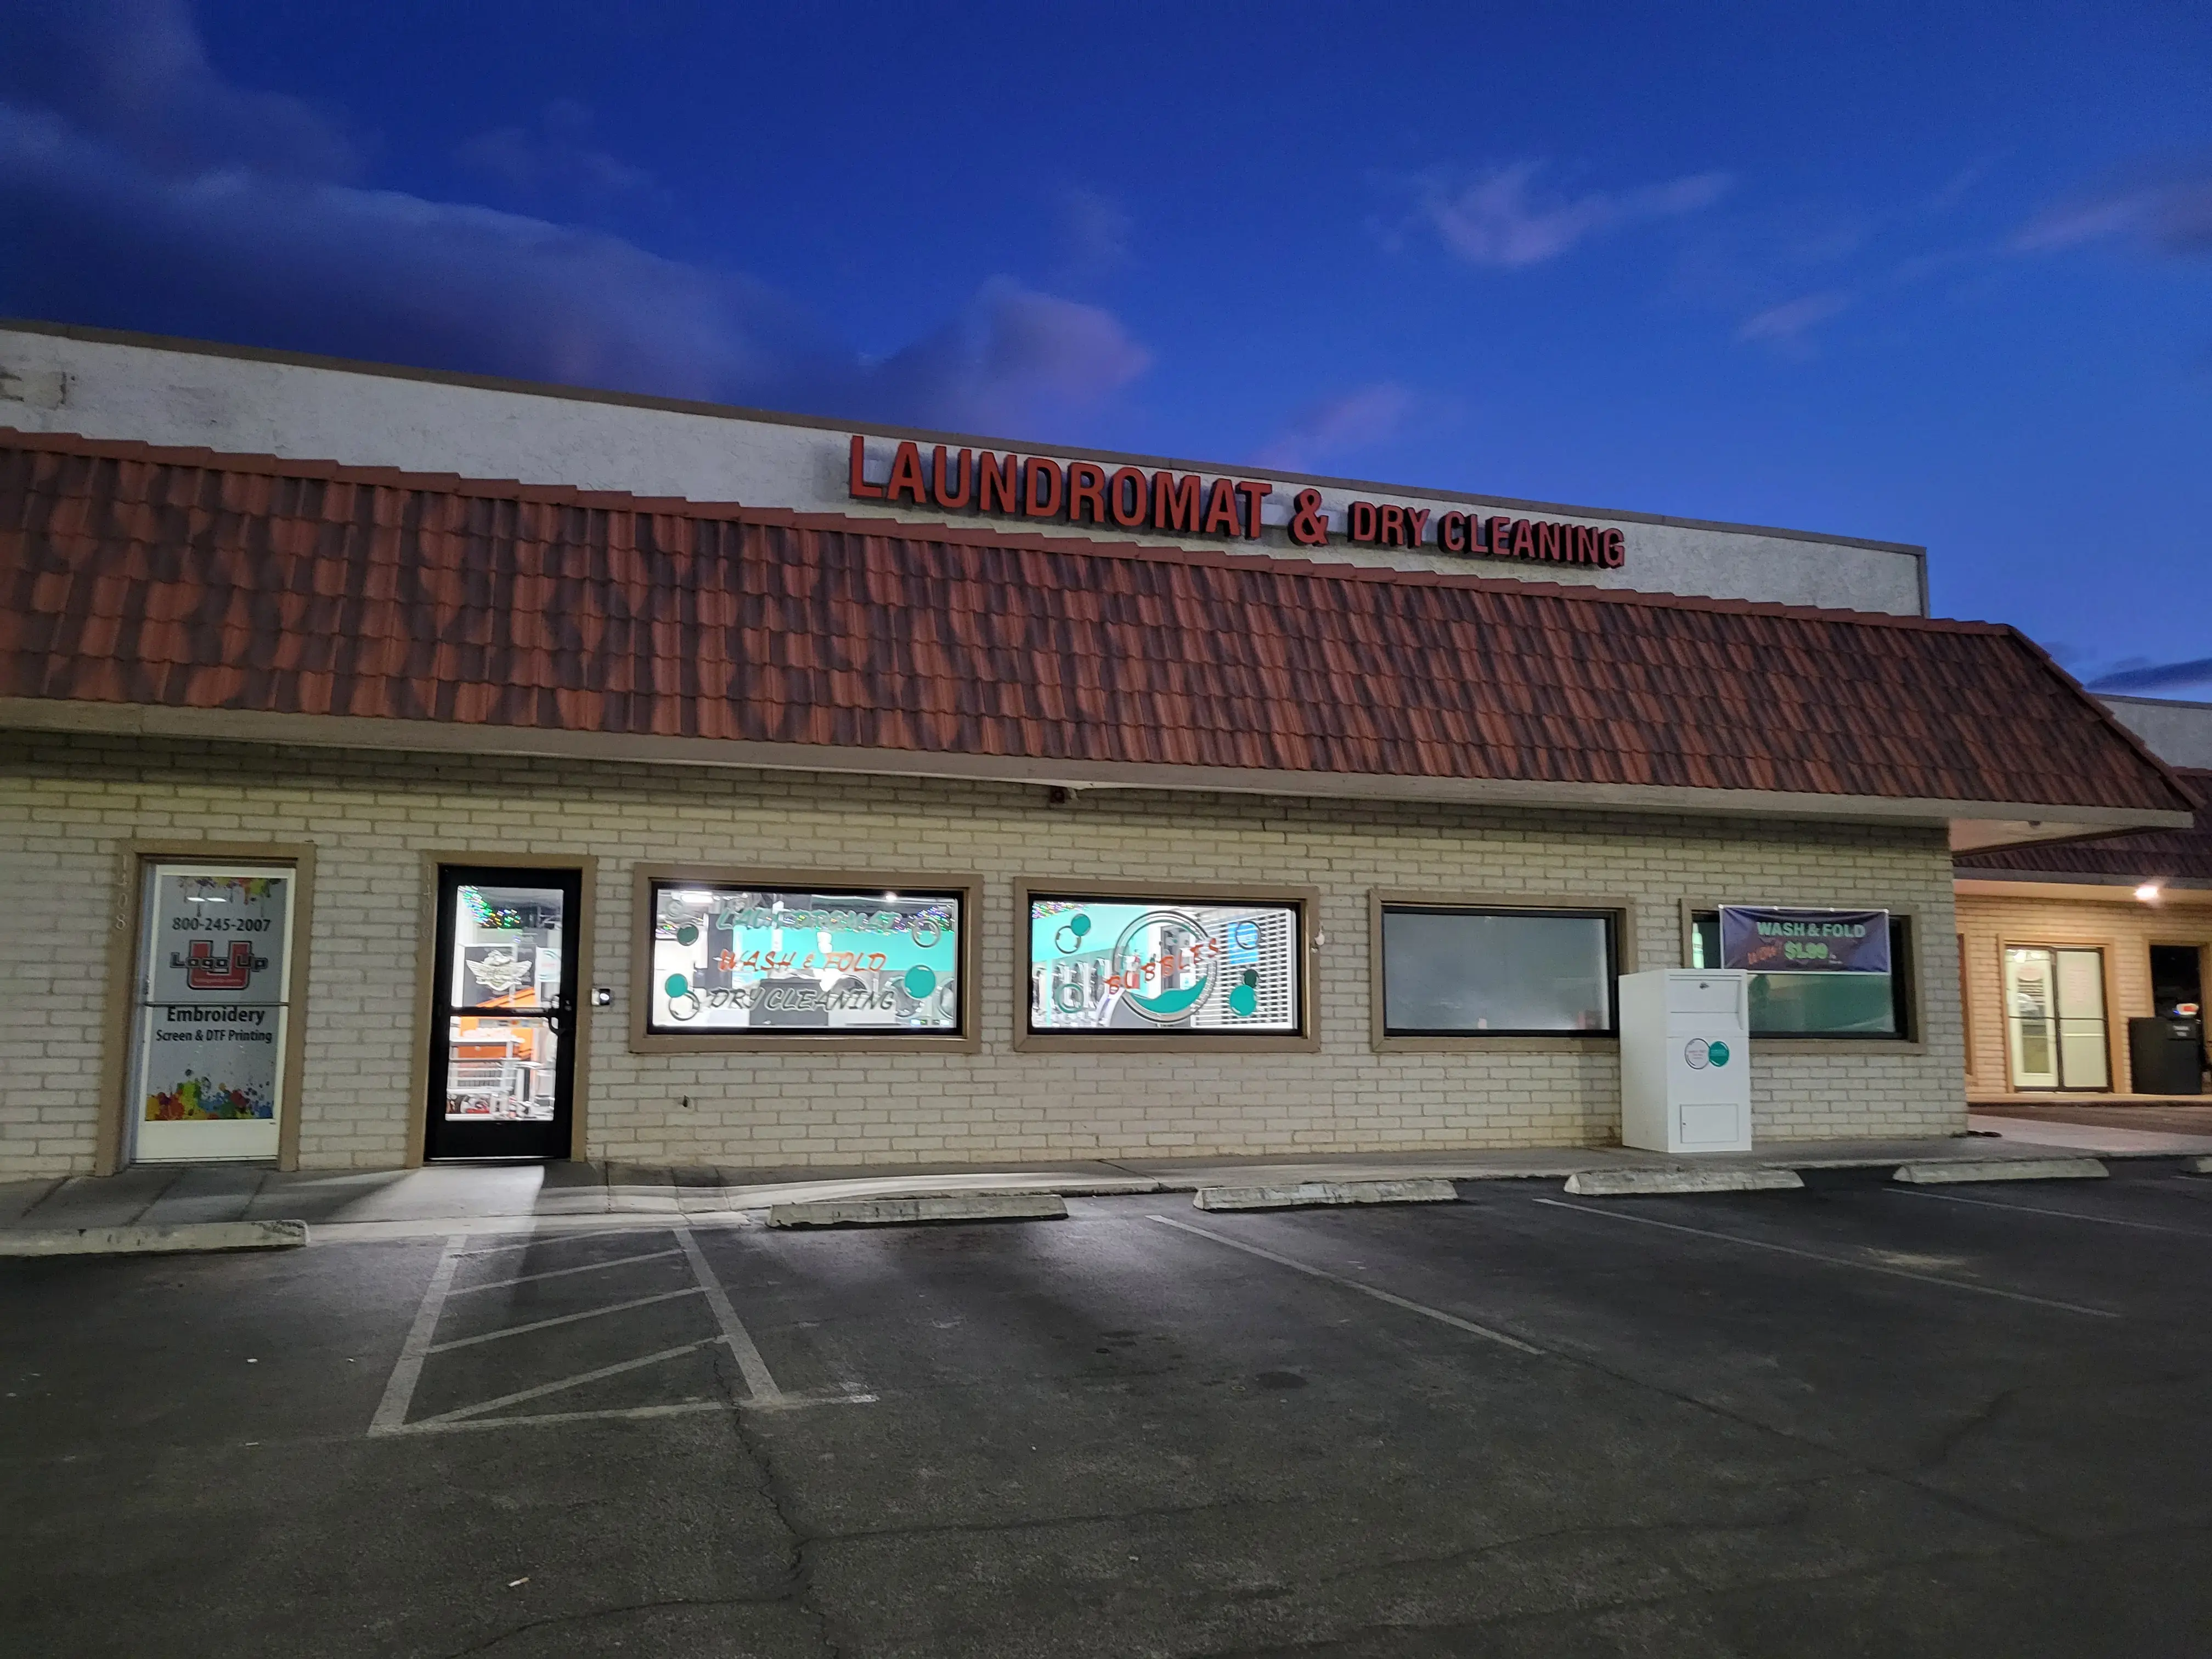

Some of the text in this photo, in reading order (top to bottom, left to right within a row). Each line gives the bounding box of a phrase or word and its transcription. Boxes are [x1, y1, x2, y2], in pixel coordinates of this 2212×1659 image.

[850, 436, 1625, 569] LAUNDROMAT & DRY CLEANING
[172, 917, 272, 932] 800-245-2007
[1756, 922, 1866, 938] WASH & FOLD
[170, 952, 269, 974] Logo Up
[717, 949, 797, 972] WASH
[823, 952, 887, 972] FOLD
[708, 987, 898, 1011] DRY CLEANING
[167, 1005, 265, 1025] Embroidery
[156, 1029, 272, 1043] Screen & DTF Printing
